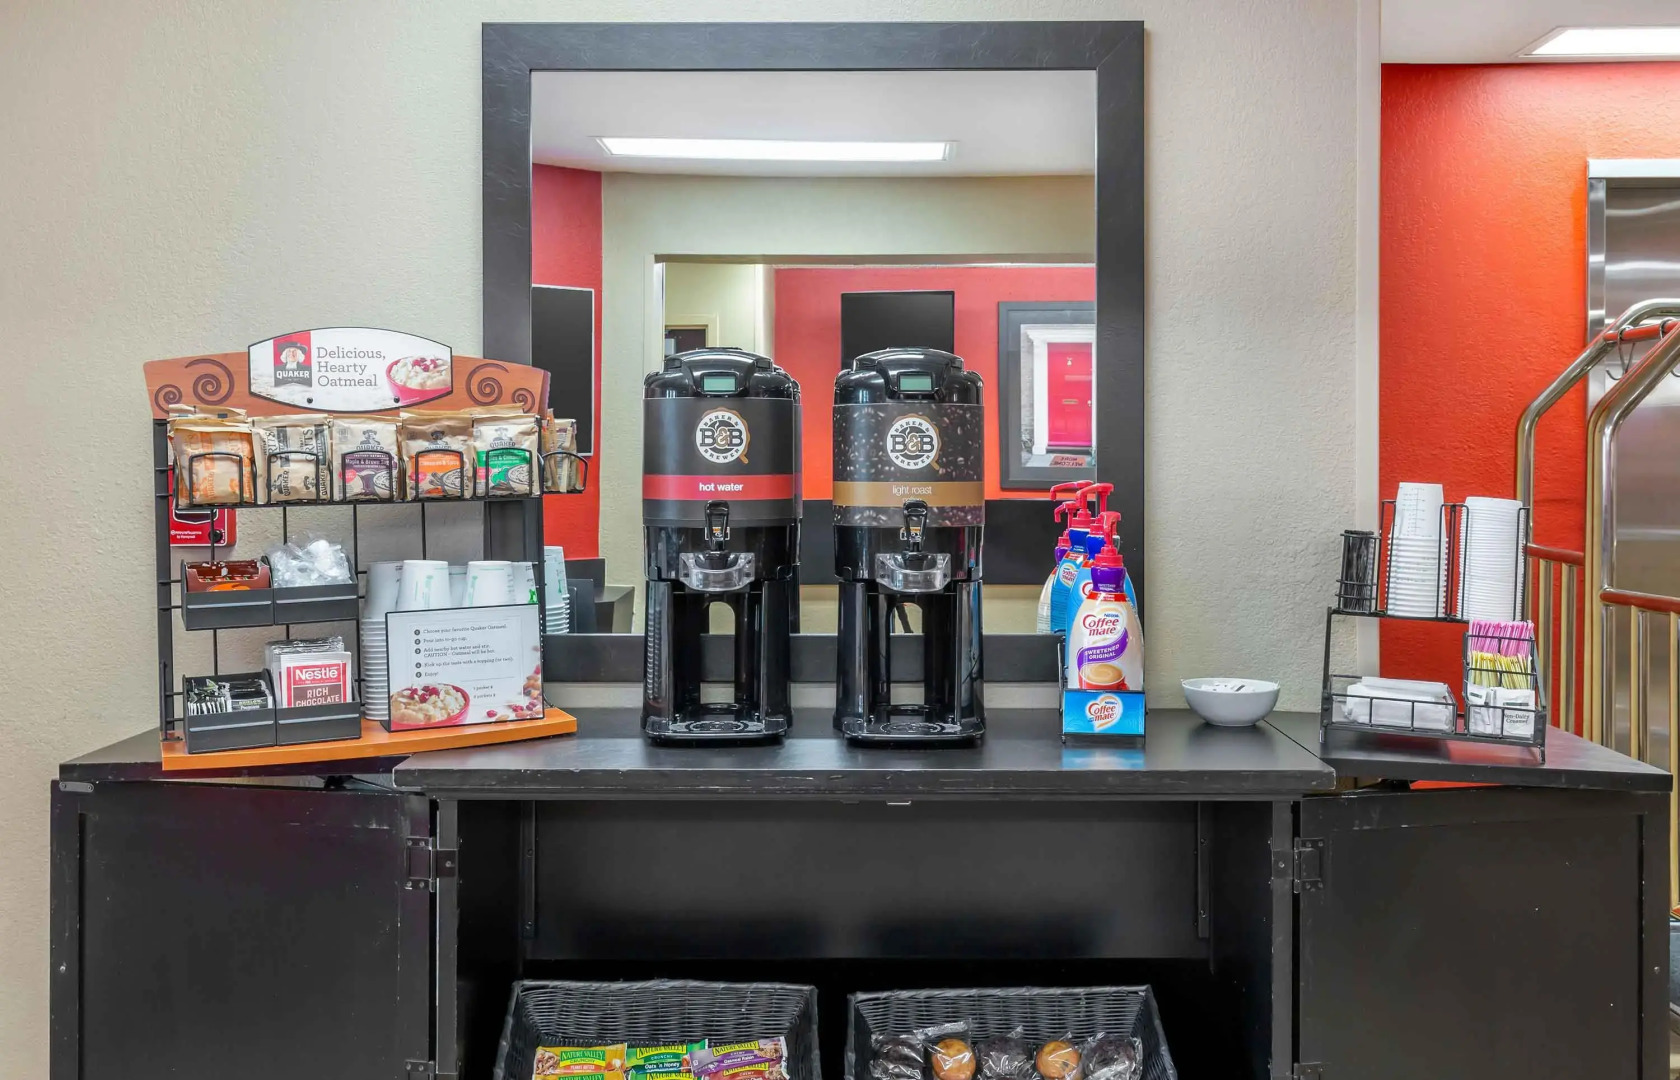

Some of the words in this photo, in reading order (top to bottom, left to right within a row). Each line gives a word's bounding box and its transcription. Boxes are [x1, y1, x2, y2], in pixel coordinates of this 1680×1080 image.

[316, 346, 386, 360] Delicious,
[276, 370, 310, 379] QUAKER
[316, 361, 367, 376] Hearty
[318, 374, 378, 387] Oatmeal
[704, 414, 732, 427] BAKER
[894, 420, 923, 433] BAKER
[700, 427, 744, 448] B&B
[890, 433, 934, 454] B&B
[704, 448, 740, 460] BREWER
[894, 454, 931, 466] BREWER
[281, 470, 290, 496] QUAKER
[698, 482, 715, 492] hot
[716, 483, 744, 492] water
[892, 486, 910, 496] light
[912, 486, 932, 494] roast
[1082, 614, 1120, 630] Coffee
[1088, 626, 1116, 636] mate
[1085, 644, 1120, 656] SWEETENED
[307, 687, 329, 698] RICH
[296, 695, 340, 707] CHOCOLATE
[1088, 702, 1116, 715] Coffee
[1095, 713, 1114, 722] mate
[584, 1051, 603, 1059] VALLEY
[715, 1045, 737, 1054] NATURE
